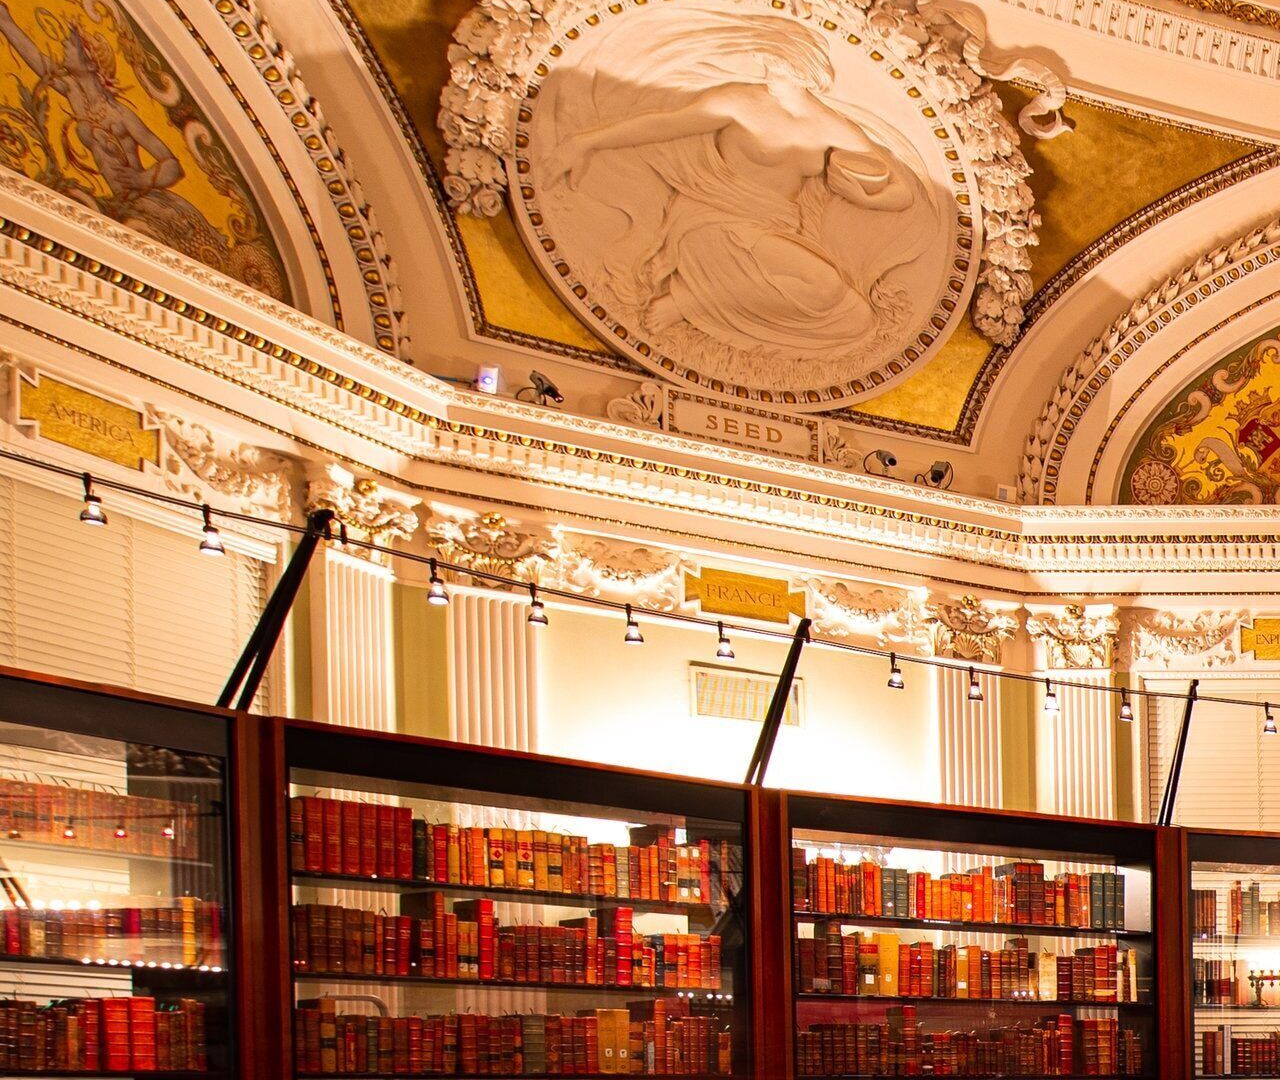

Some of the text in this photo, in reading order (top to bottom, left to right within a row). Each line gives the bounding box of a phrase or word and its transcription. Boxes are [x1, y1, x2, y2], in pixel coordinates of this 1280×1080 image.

[47, 402, 136, 448] AMERICA
[706, 414, 784, 444] SEED
[706, 583, 783, 608] FRANCE
